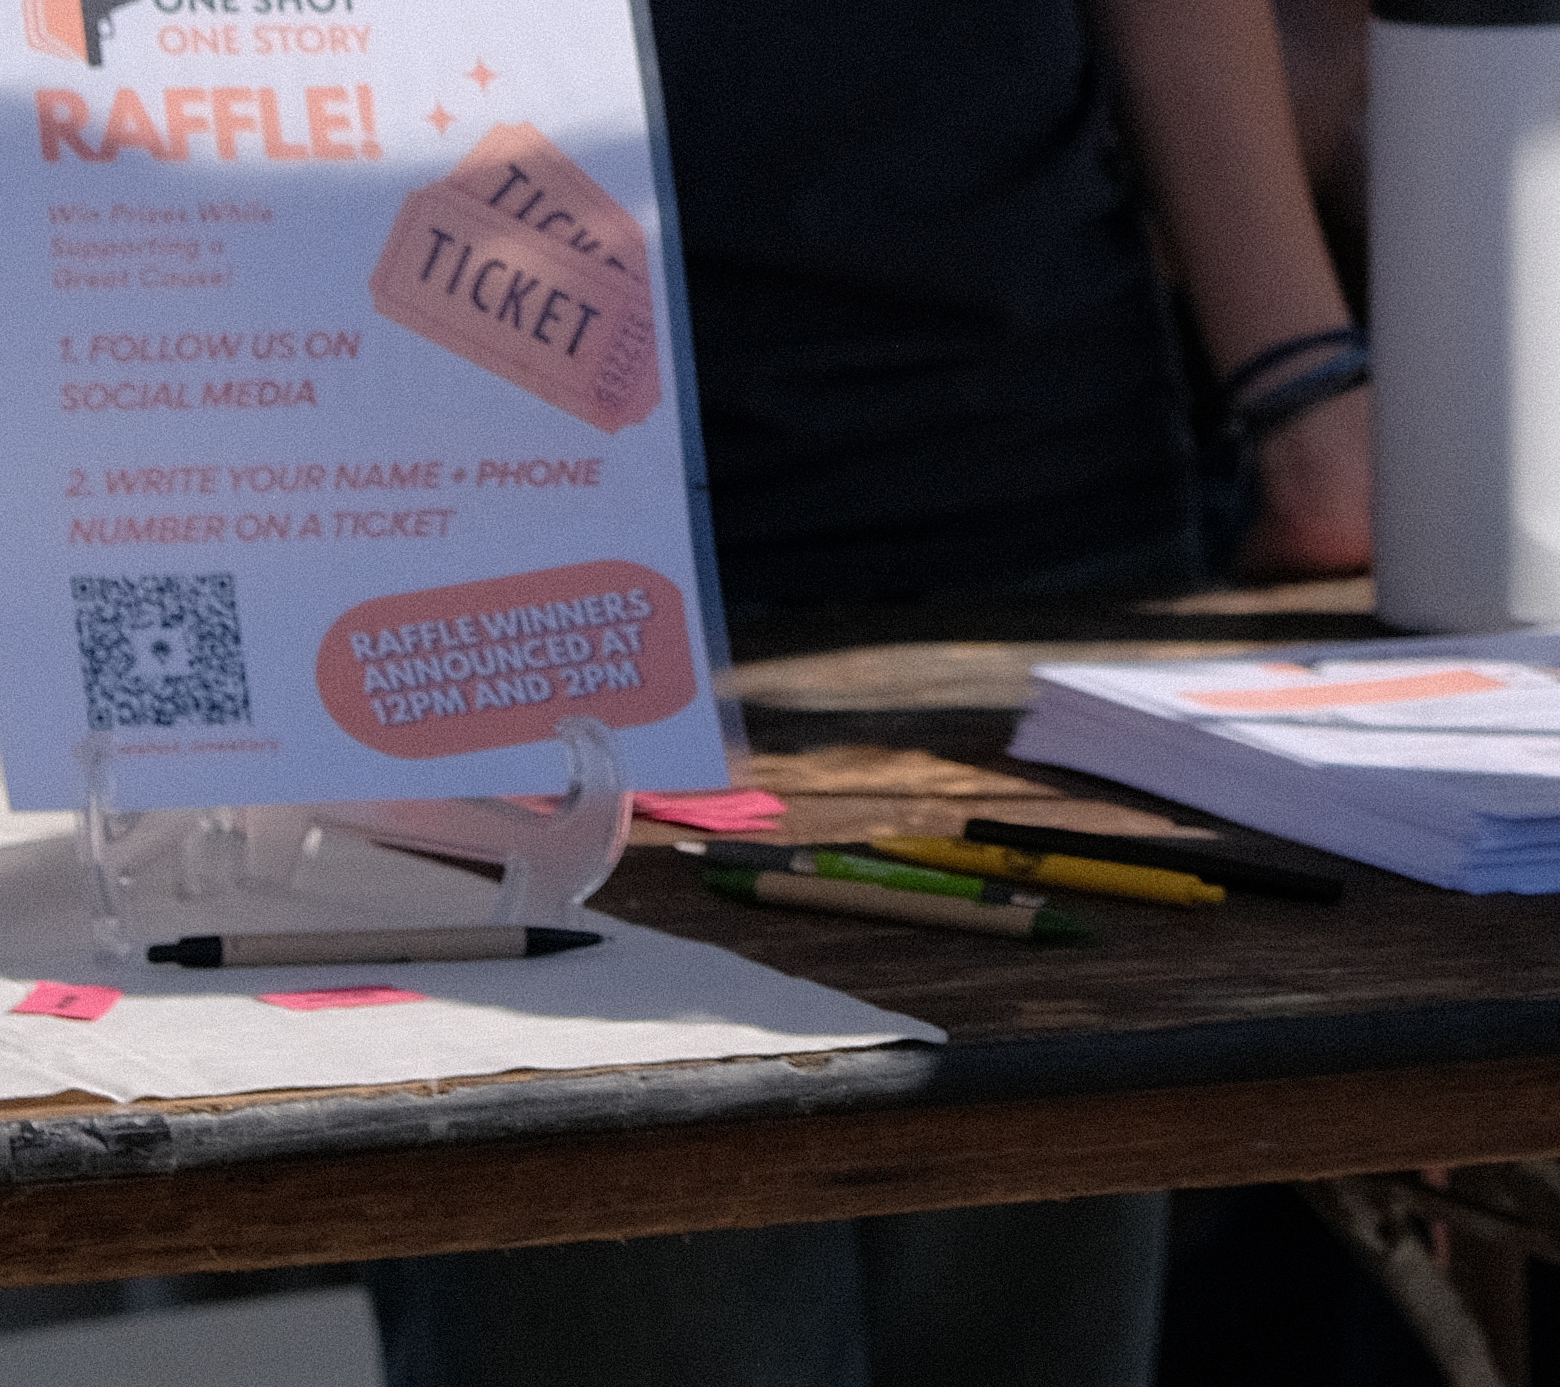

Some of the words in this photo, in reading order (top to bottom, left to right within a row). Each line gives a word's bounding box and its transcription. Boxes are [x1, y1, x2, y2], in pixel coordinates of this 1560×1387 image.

[156, 25, 241, 56] ONE
[253, 24, 372, 56] STORY
[35, 83, 384, 163] RAFFLE!
[50, 235, 201, 263] Supporting
[421, 227, 602, 356] TICKET
[59, 334, 80, 363] 1.
[89, 332, 239, 363] FOLLOW
[250, 331, 298, 360] US
[304, 330, 362, 360] ON
[60, 381, 192, 412] SOCIAL
[200, 379, 318, 409] MEDIA
[65, 467, 94, 498] 2.
[103, 465, 221, 496] WRITE
[228, 463, 328, 493] YOUR
[333, 460, 441, 492] NAME
[475, 458, 604, 489] PHONE
[67, 514, 227, 546] NUMBER
[234, 513, 290, 543] ON
[297, 512, 324, 540] A
[333, 508, 455, 540] TICKET
[350, 615, 480, 663] RAFFLE
[479, 588, 653, 641] WINNERS
[363, 633, 594, 695] ANNOUNCED
[601, 624, 643, 658] AT
[370, 685, 468, 726] 12PM
[474, 674, 554, 711] AND
[561, 659, 640, 699] 2PM
